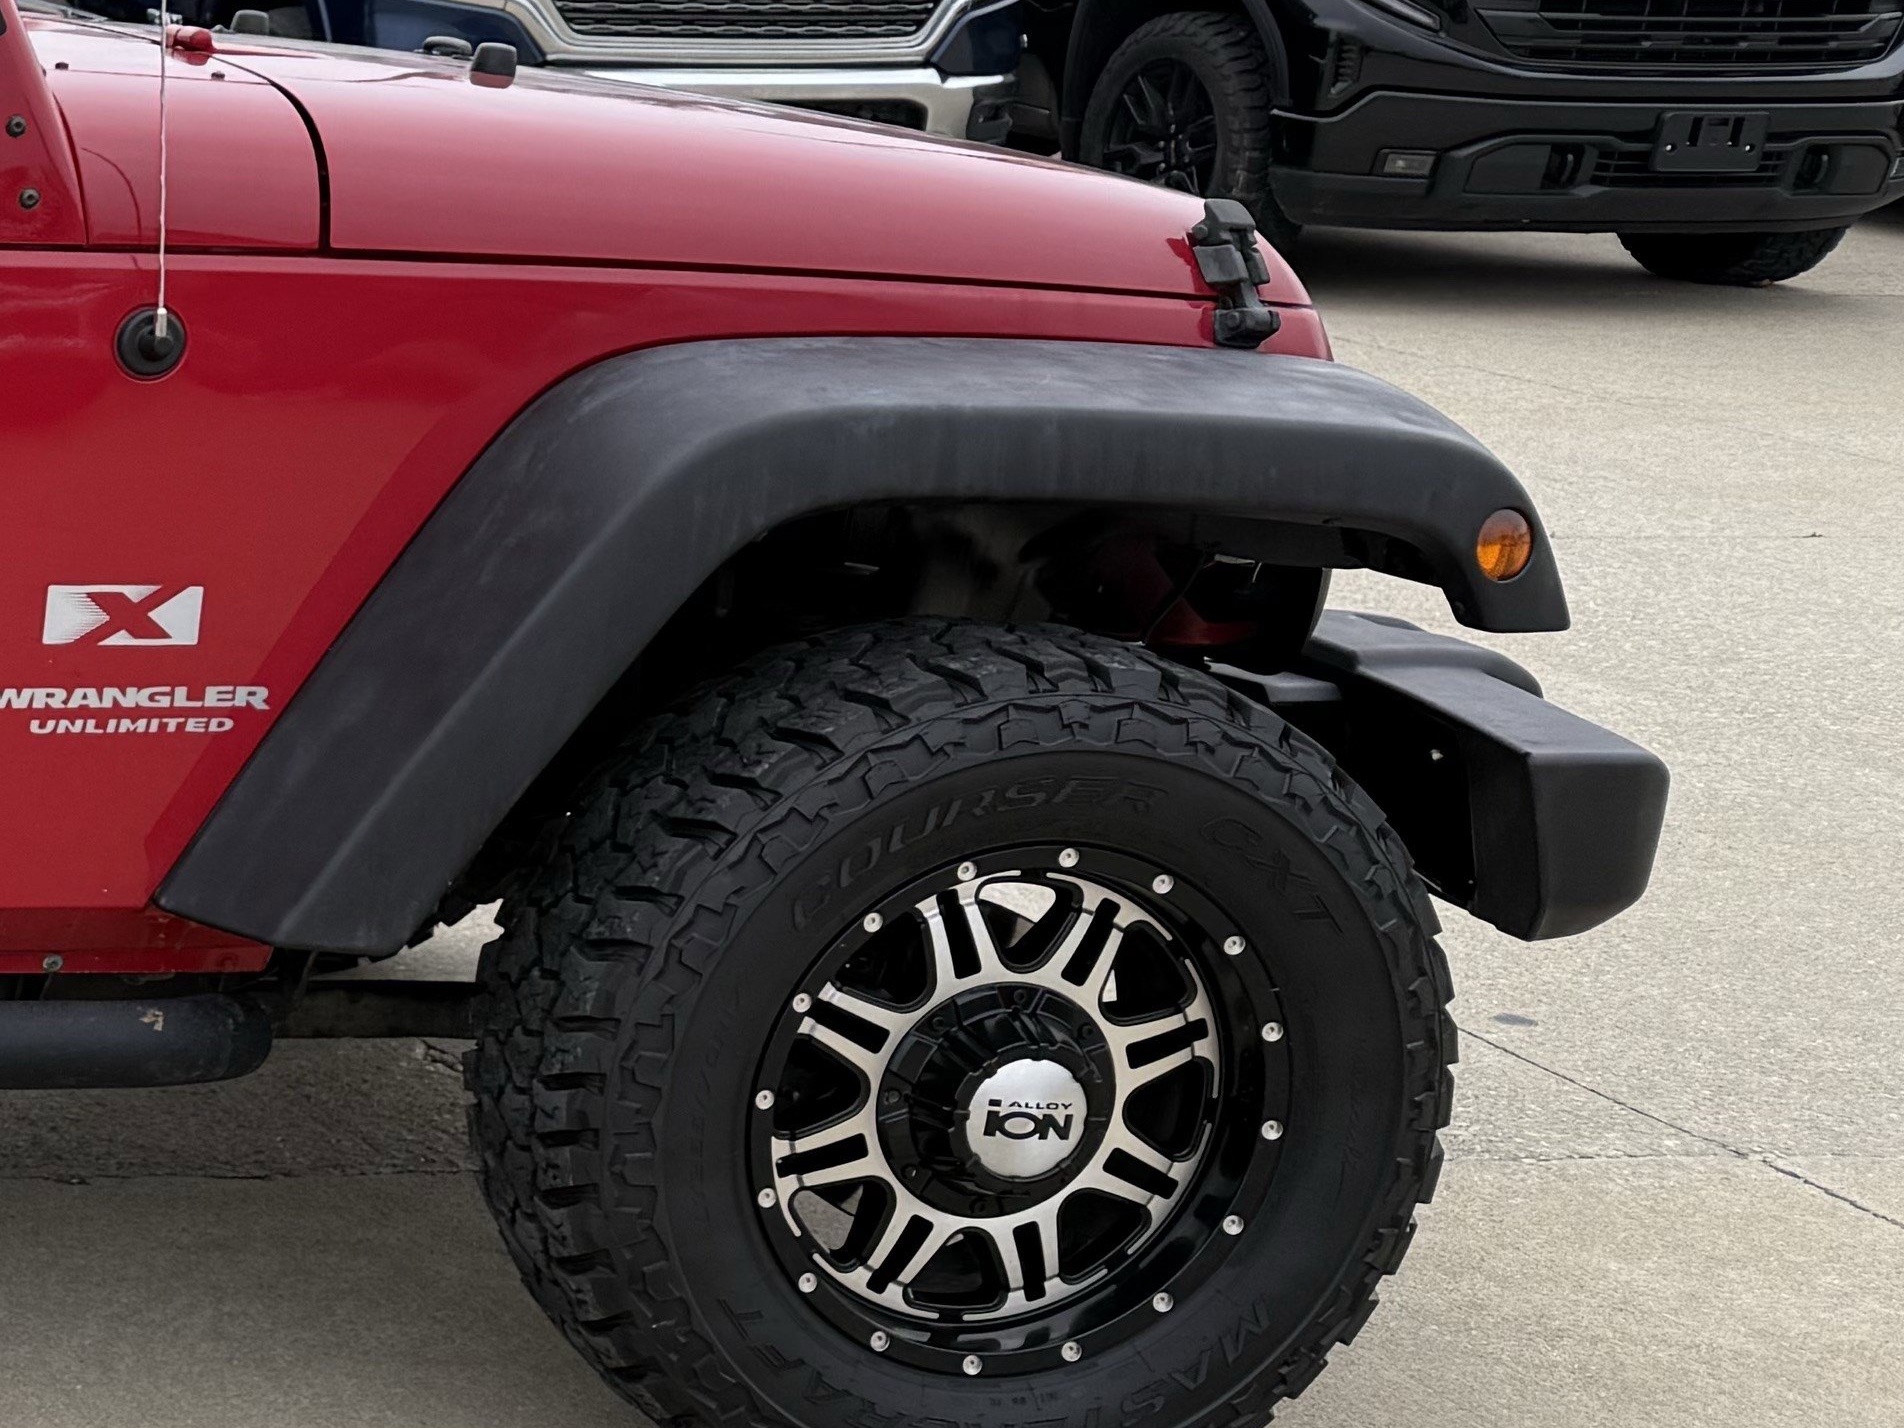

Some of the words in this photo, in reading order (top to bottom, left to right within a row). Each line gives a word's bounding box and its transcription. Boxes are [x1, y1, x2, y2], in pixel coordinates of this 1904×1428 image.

[50, 584, 200, 646] X
[29, 717, 235, 735] UNLIMITED
[788, 776, 1173, 933] COURSER
[1198, 816, 1350, 936] CXT
[1008, 1100, 1073, 1110] ALLOY
